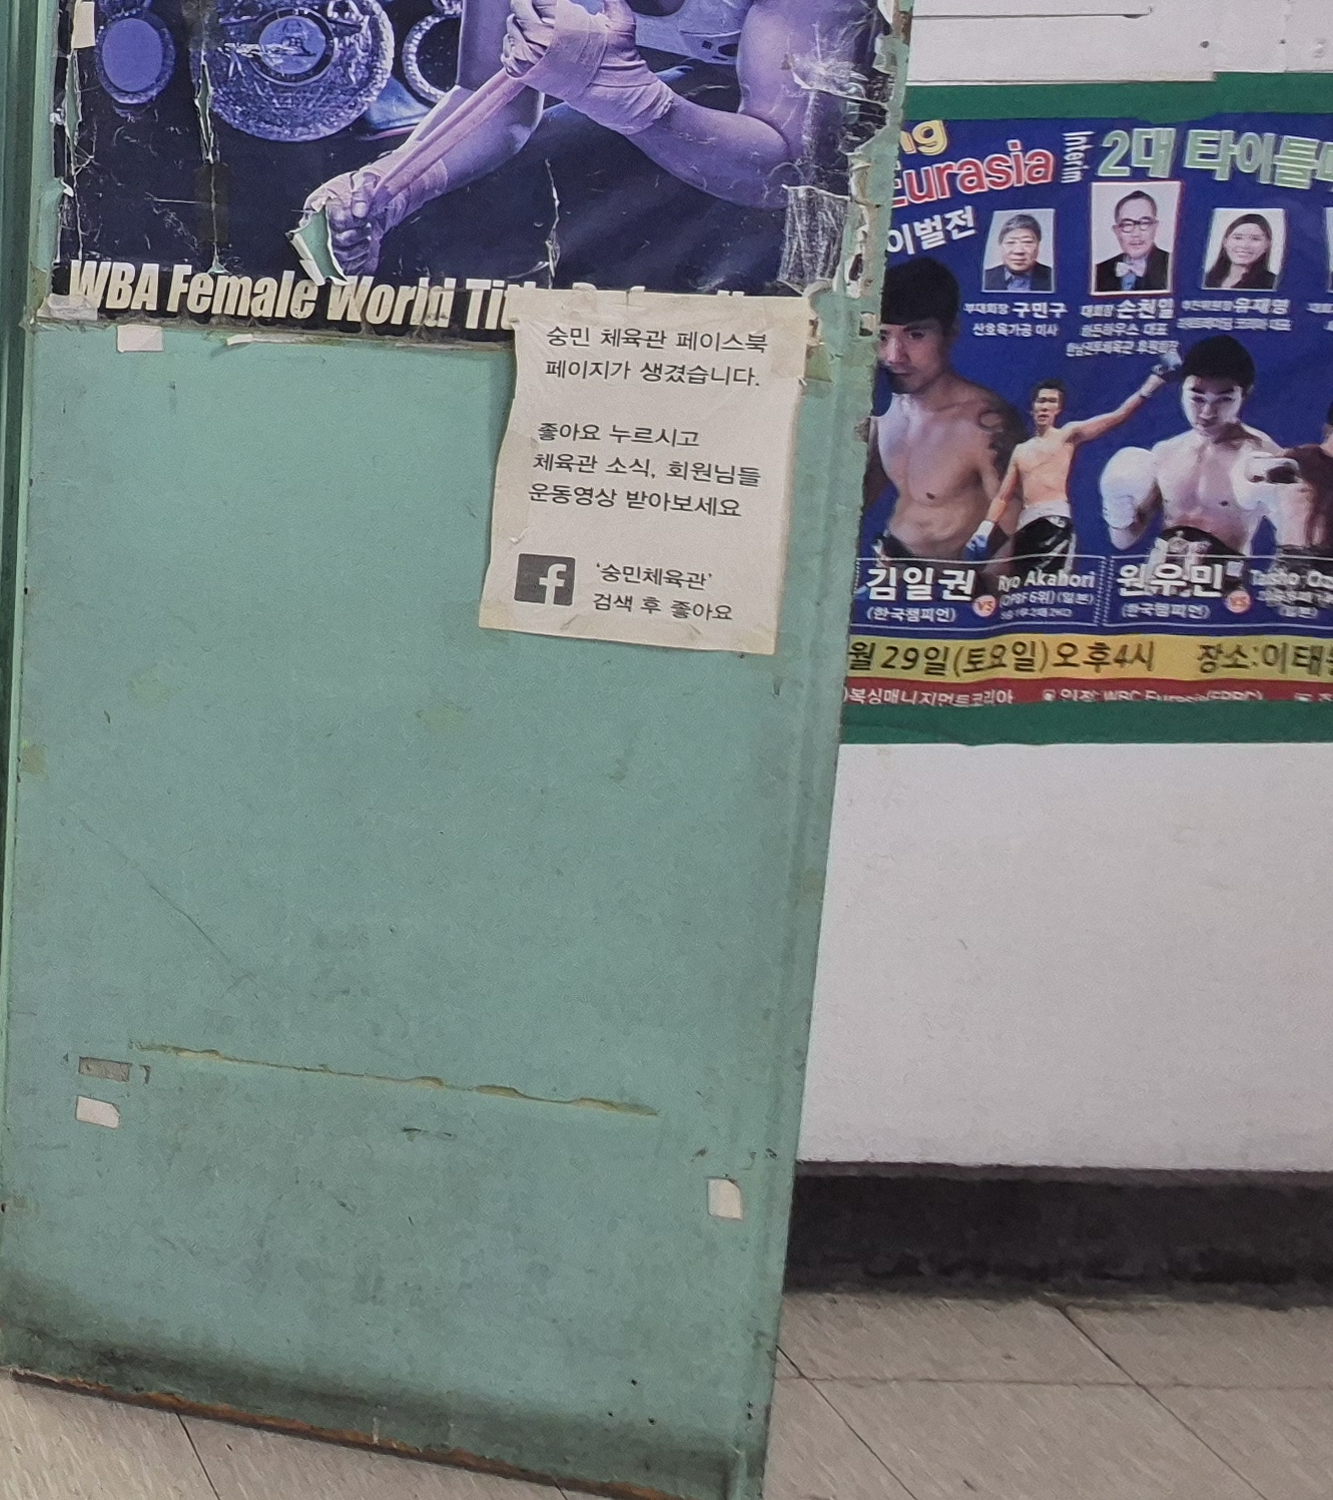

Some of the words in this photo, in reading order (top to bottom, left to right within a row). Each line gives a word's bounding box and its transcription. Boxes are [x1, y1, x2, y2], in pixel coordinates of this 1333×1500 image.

[1097, 126, 1178, 178] 2대
[68, 260, 162, 312] WBA
[165, 264, 321, 320] Female
[326, 275, 457, 330] World
[546, 325, 591, 348] 숭민
[600, 327, 668, 351] 체육관
[675, 330, 769, 354] 페이스북
[545, 359, 632, 381] 페이지가
[639, 361, 760, 388] 생겼습니다.
[537, 421, 602, 443] 좋아요
[608, 424, 701, 448] 누르시고
[532, 452, 598, 475] 체육관
[605, 455, 657, 479] 소식,
[666, 460, 762, 488] 회원님들
[527, 482, 619, 508] 운동영상
[625, 489, 743, 518] 받아보세요
[866, 566, 976, 603] 김일권
[1023, 568, 1096, 589] Akahori
[592, 592, 634, 612] 검색
[640, 596, 662, 616] 후
[669, 599, 734, 621] 좋아요
[866, 606, 957, 623] (한국챔피언)
[847, 641, 876, 672] 월
